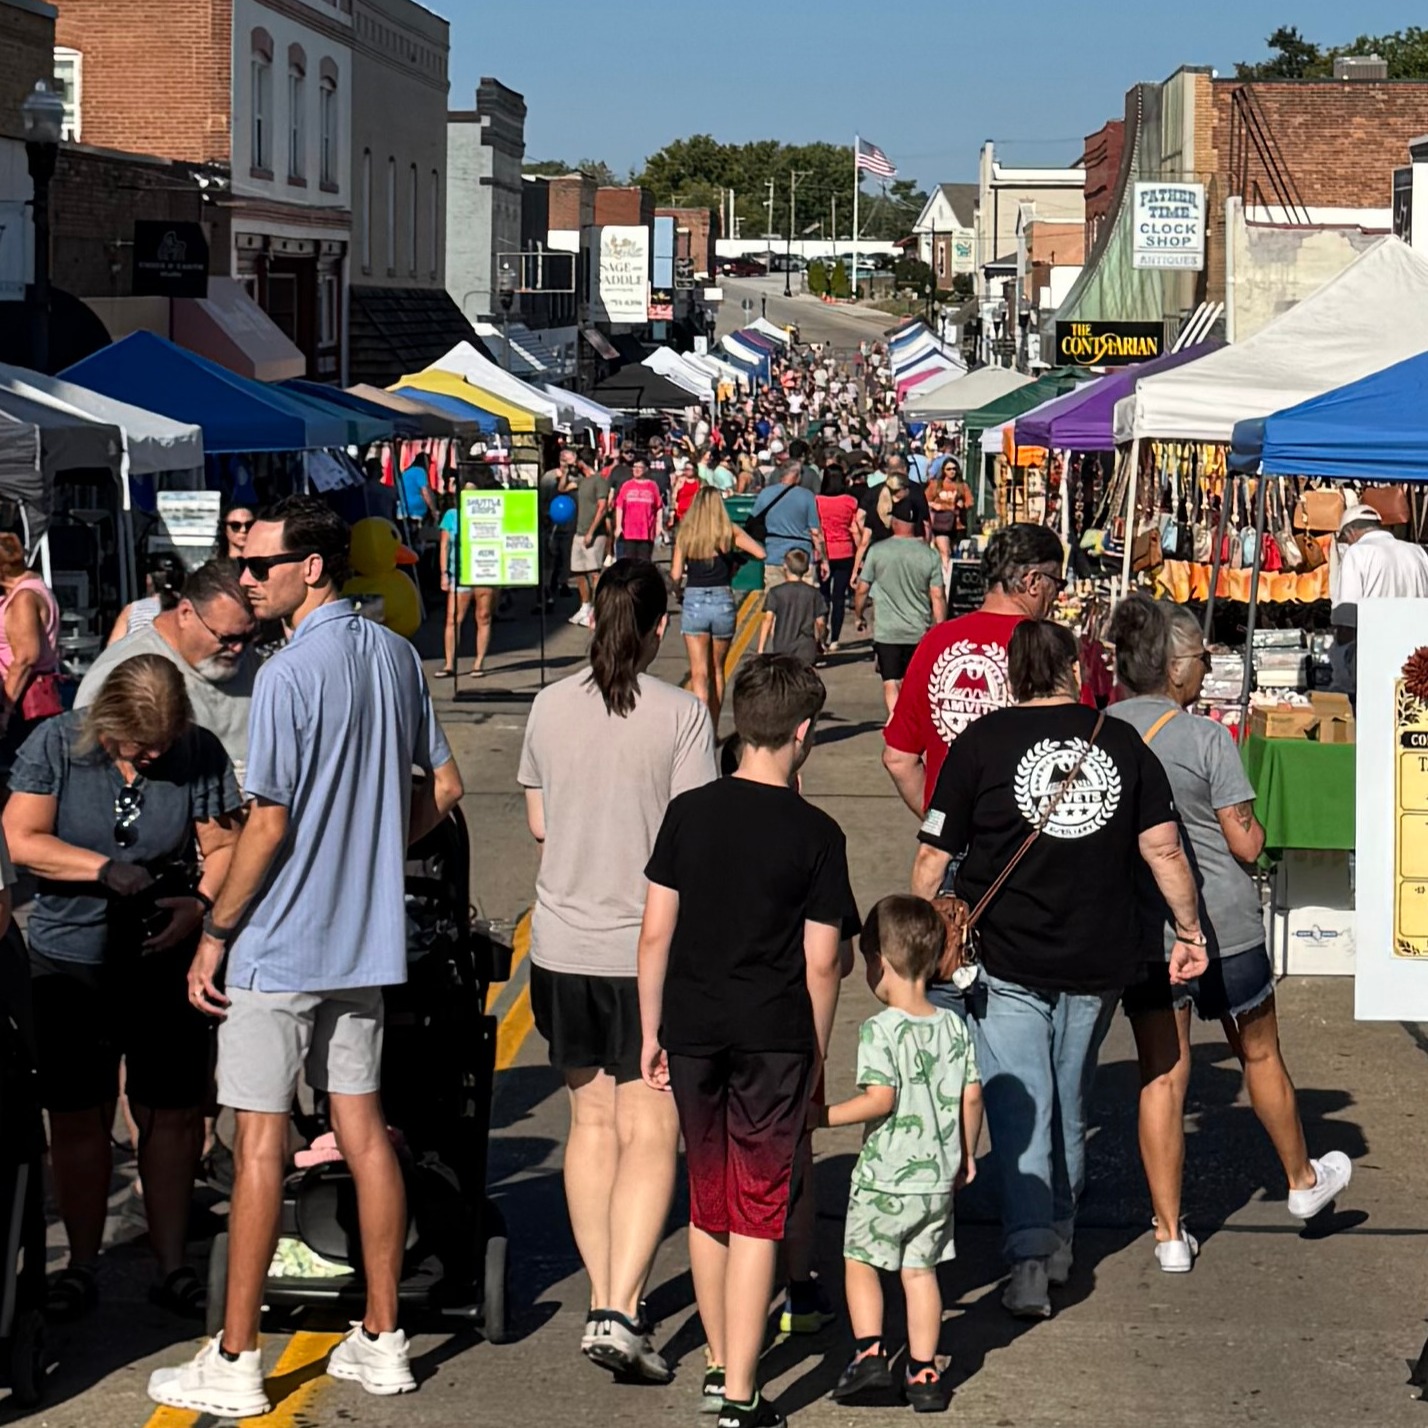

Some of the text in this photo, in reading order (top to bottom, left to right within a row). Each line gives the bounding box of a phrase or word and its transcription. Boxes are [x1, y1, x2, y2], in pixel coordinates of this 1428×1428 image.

[1140, 189, 1198, 209] FATHER
[1148, 206, 1190, 219] TIME
[1140, 223, 1196, 235] CLOCK
[1146, 235, 1192, 247] SHOP
[1139, 255, 1198, 266] ANTIQUES
[1070, 323, 1092, 337] THE
[1040, 791, 1102, 808] AVETS
